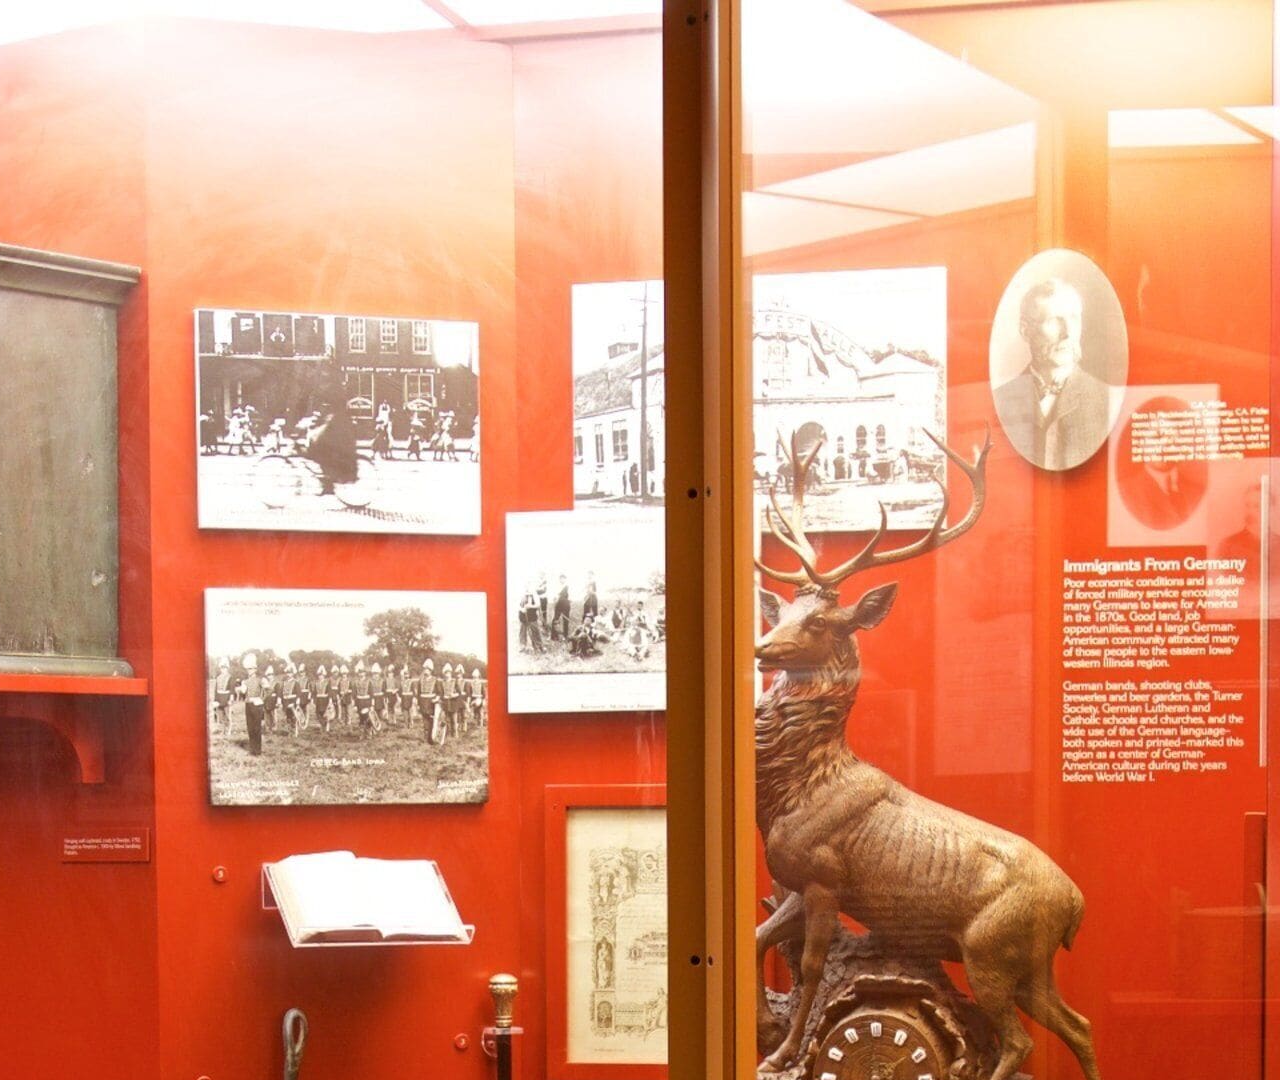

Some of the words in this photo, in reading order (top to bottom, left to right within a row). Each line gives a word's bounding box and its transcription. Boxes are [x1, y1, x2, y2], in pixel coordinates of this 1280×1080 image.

[1064, 559, 1141, 575] Immigrants
[1145, 558, 1180, 571] From
[1184, 558, 1246, 571] Germany
[1064, 578, 1085, 588] Poor
[1088, 578, 1133, 587] economic
[1136, 577, 1184, 586] conditions
[1187, 577, 1204, 585] and
[1206, 577, 1214, 586] a
[1215, 576, 1244, 585] dislike
[1064, 590, 1073, 599] of
[1075, 589, 1105, 599] forced
[1108, 589, 1144, 600] military
[1146, 589, 1179, 598] service
[1181, 589, 1238, 600] encouraged
[1064, 603, 1091, 612] many
[1093, 601, 1138, 611] Germans
[1141, 601, 1151, 609] to
[1153, 600, 1178, 609] leave
[1181, 599, 1194, 609] for
[1196, 599, 1237, 609] America
[1064, 614, 1073, 622] in
[1075, 612, 1091, 622] the
[1129, 611, 1156, 621] Good
[1185, 611, 1200, 622] job
[1134, 623, 1153, 632] and
[1165, 623, 1189, 635] large
[1063, 636, 1109, 645] American
[1111, 635, 1165, 646] community
[1168, 634, 1209, 643] attracted
[1212, 635, 1239, 645] many
[1063, 647, 1073, 656] of
[1075, 647, 1101, 656] those
[1104, 646, 1137, 659] people
[1140, 647, 1149, 656] to
[1152, 646, 1167, 655] the
[1170, 647, 1205, 655] eastern
[1063, 660, 1100, 668] western
[1103, 658, 1134, 667] Illinois
[1137, 658, 1169, 669] region.
[1063, 681, 1103, 691] German
[1140, 681, 1182, 692] shooting
[1064, 693, 1107, 702] breweries
[1109, 692, 1127, 702] and
[1129, 692, 1150, 701] beer
[1194, 691, 1209, 701] the
[1212, 691, 1242, 701] Turner
